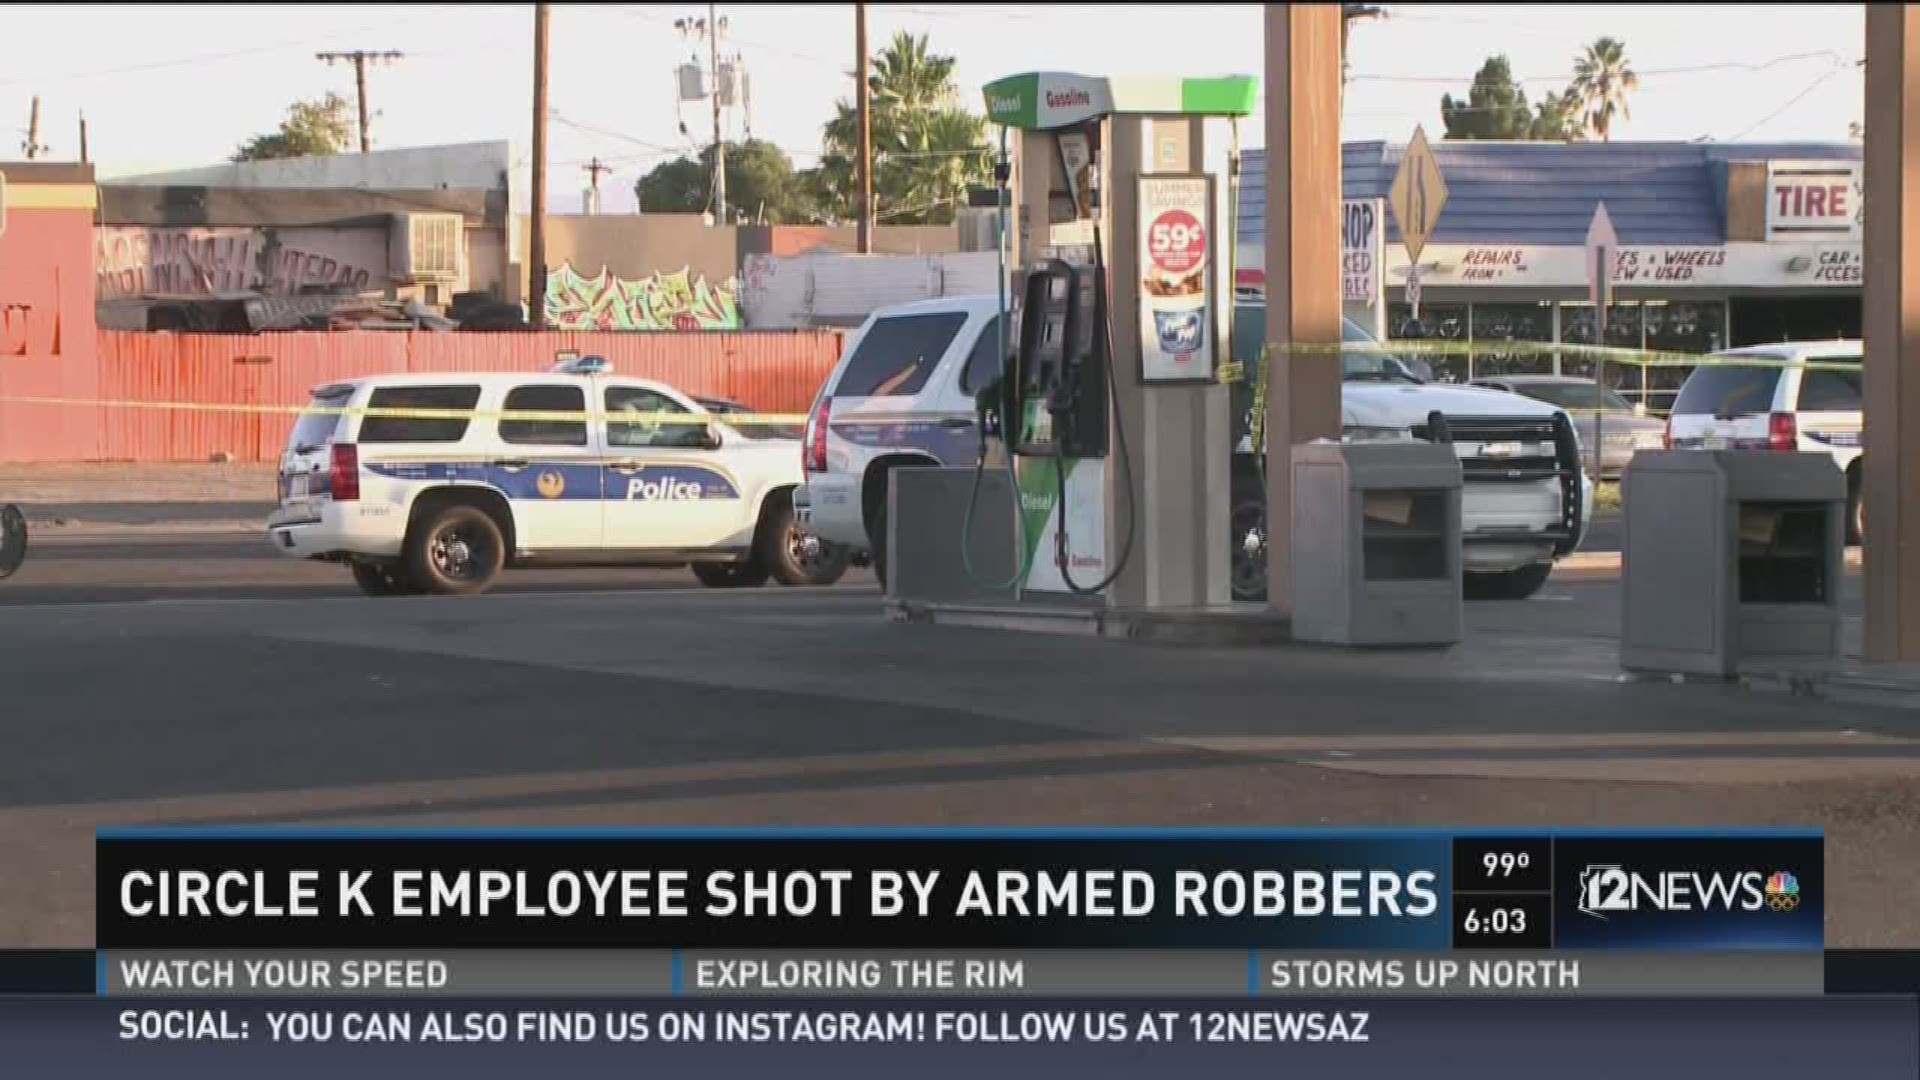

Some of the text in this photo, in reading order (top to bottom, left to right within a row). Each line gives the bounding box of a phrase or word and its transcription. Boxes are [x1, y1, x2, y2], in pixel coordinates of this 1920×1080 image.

[991, 94, 1021, 113] Diesel
[1045, 89, 1090, 107] Gasoline
[1775, 185, 1848, 217] TIRE
[1462, 250, 1523, 265] REPAIRS
[1664, 250, 1726, 266] WHEELS
[1818, 251, 1850, 265] CAR
[1655, 266, 1693, 280] USED
[626, 476, 702, 502] Police
[1021, 492, 1052, 510] Diesel
